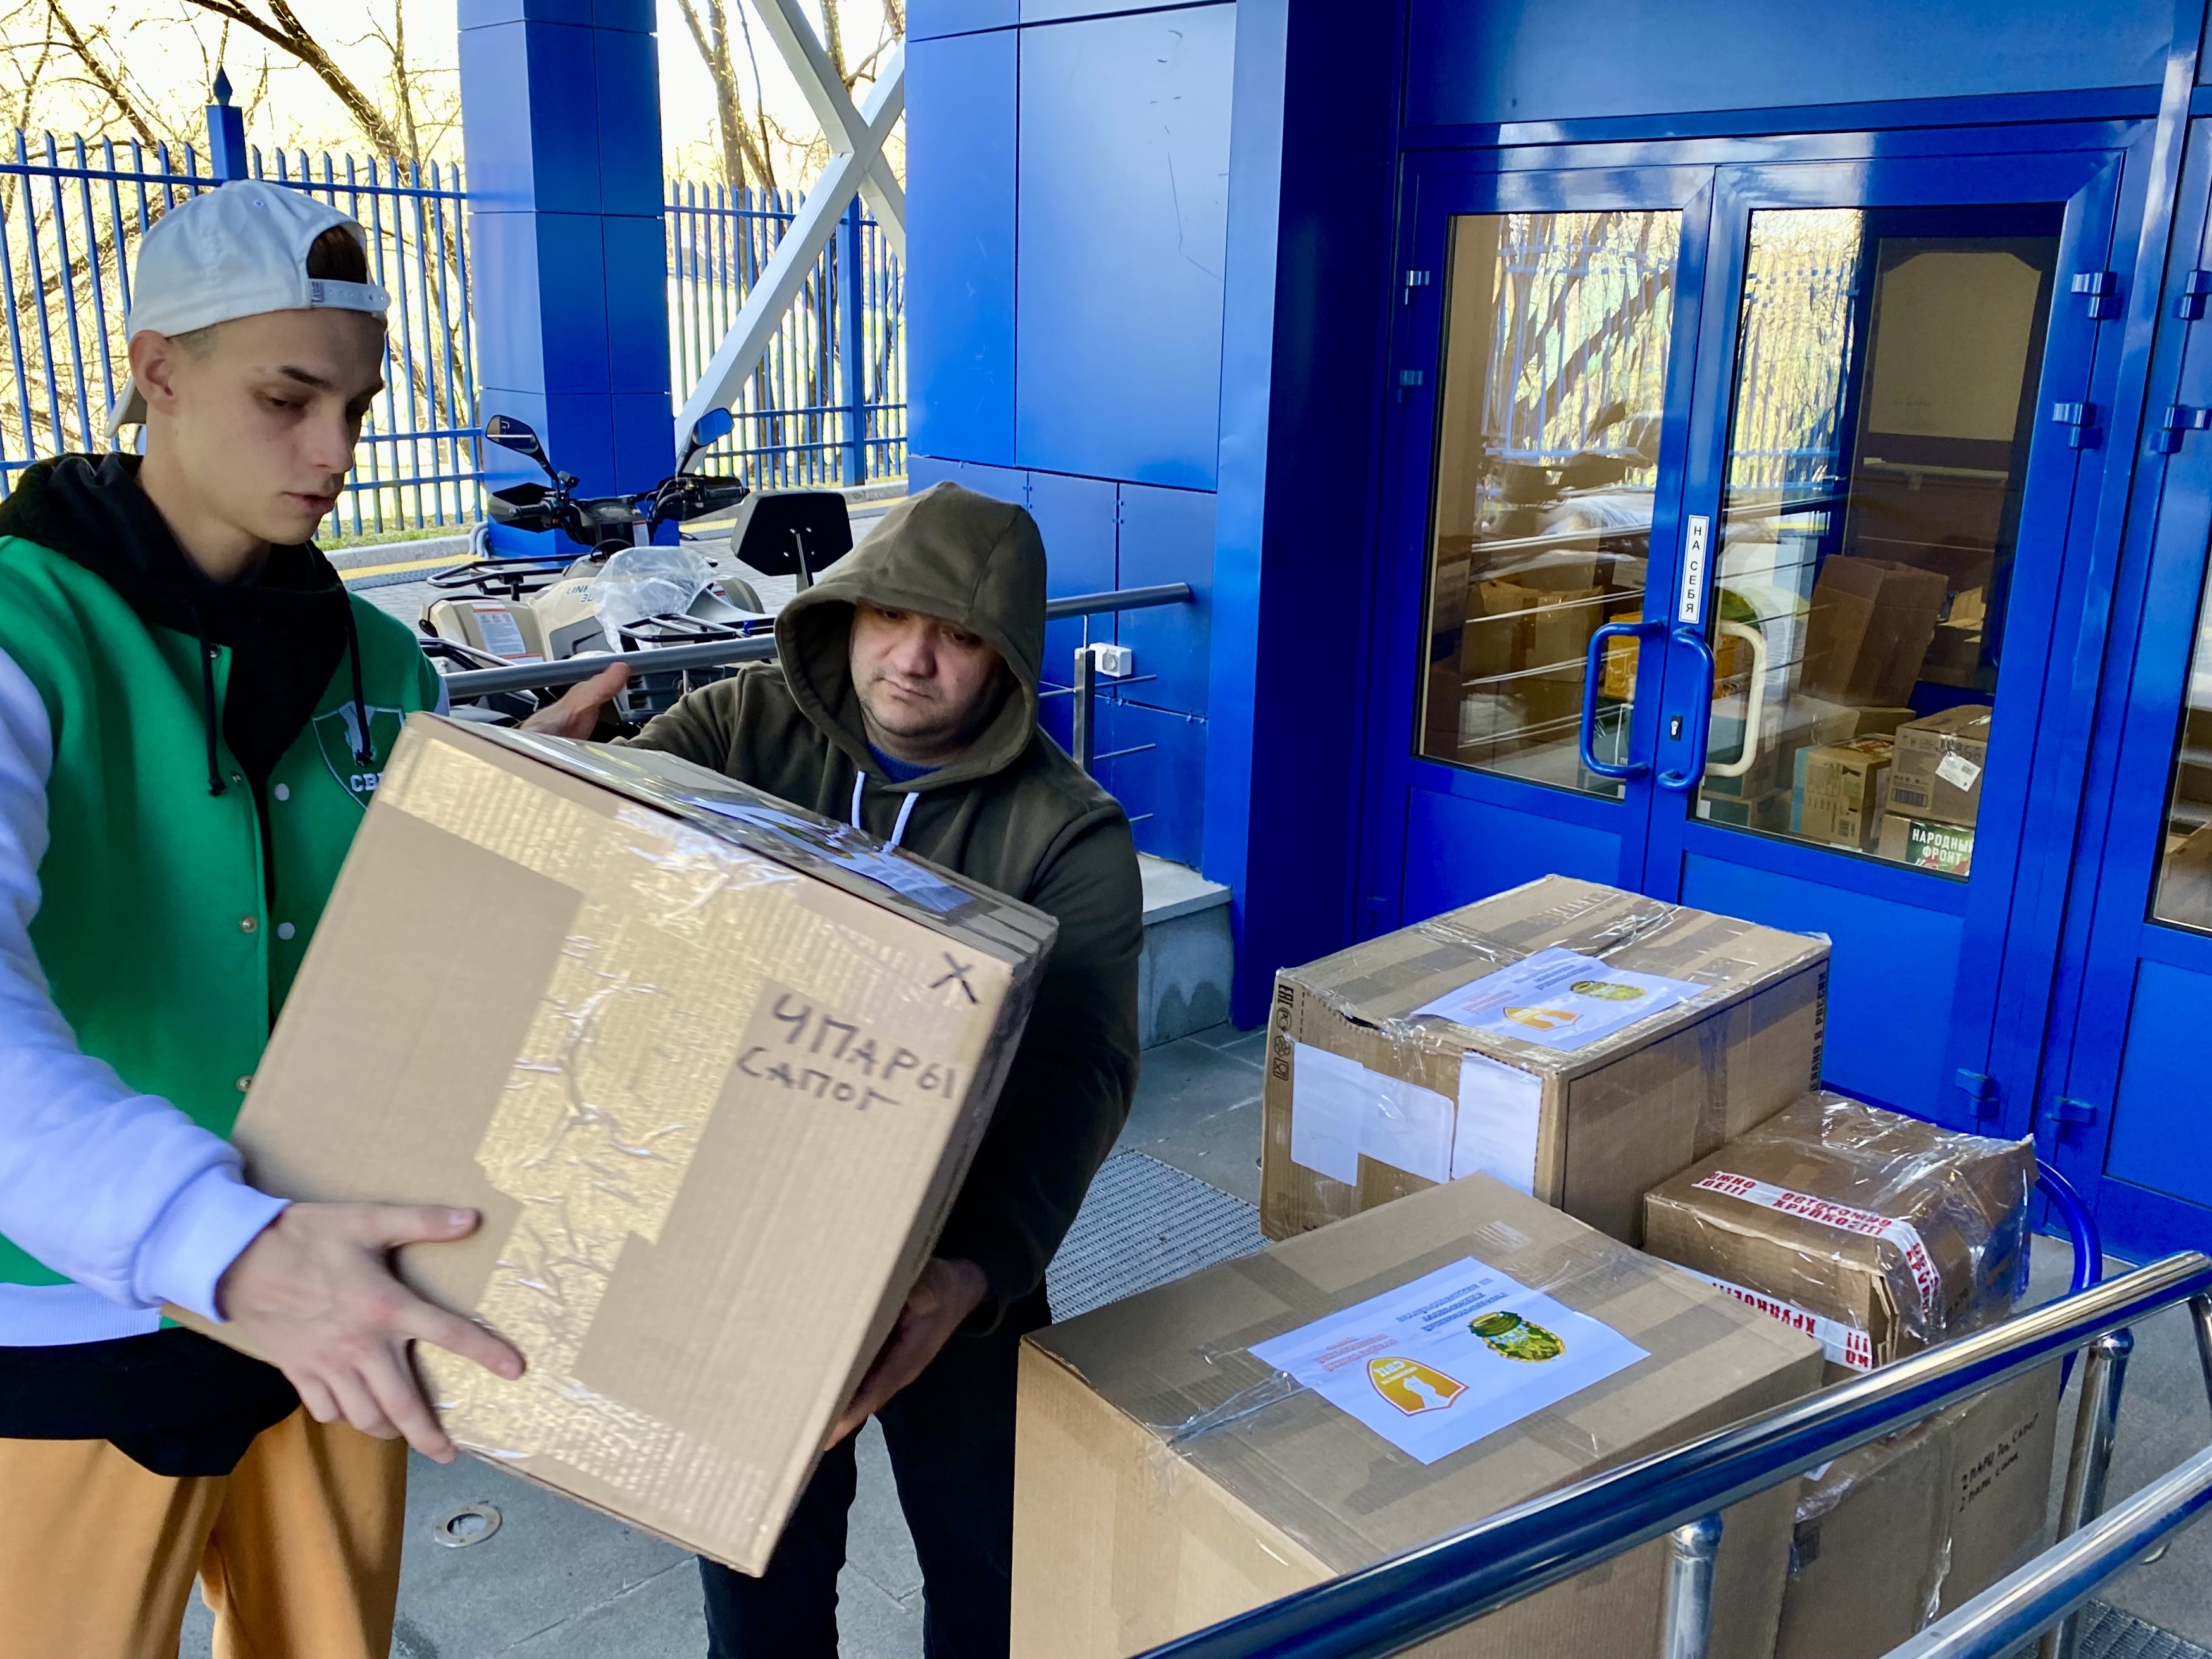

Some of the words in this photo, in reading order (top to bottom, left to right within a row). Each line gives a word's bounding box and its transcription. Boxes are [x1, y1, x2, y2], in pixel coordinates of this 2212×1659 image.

[1692, 525, 1702, 550] НА
[1686, 561, 1698, 613] СЕБЯ
[350, 772, 384, 792] СВ
[1922, 846, 1963, 865] ФРОНТ
[736, 1046, 901, 1111] САПОГ
